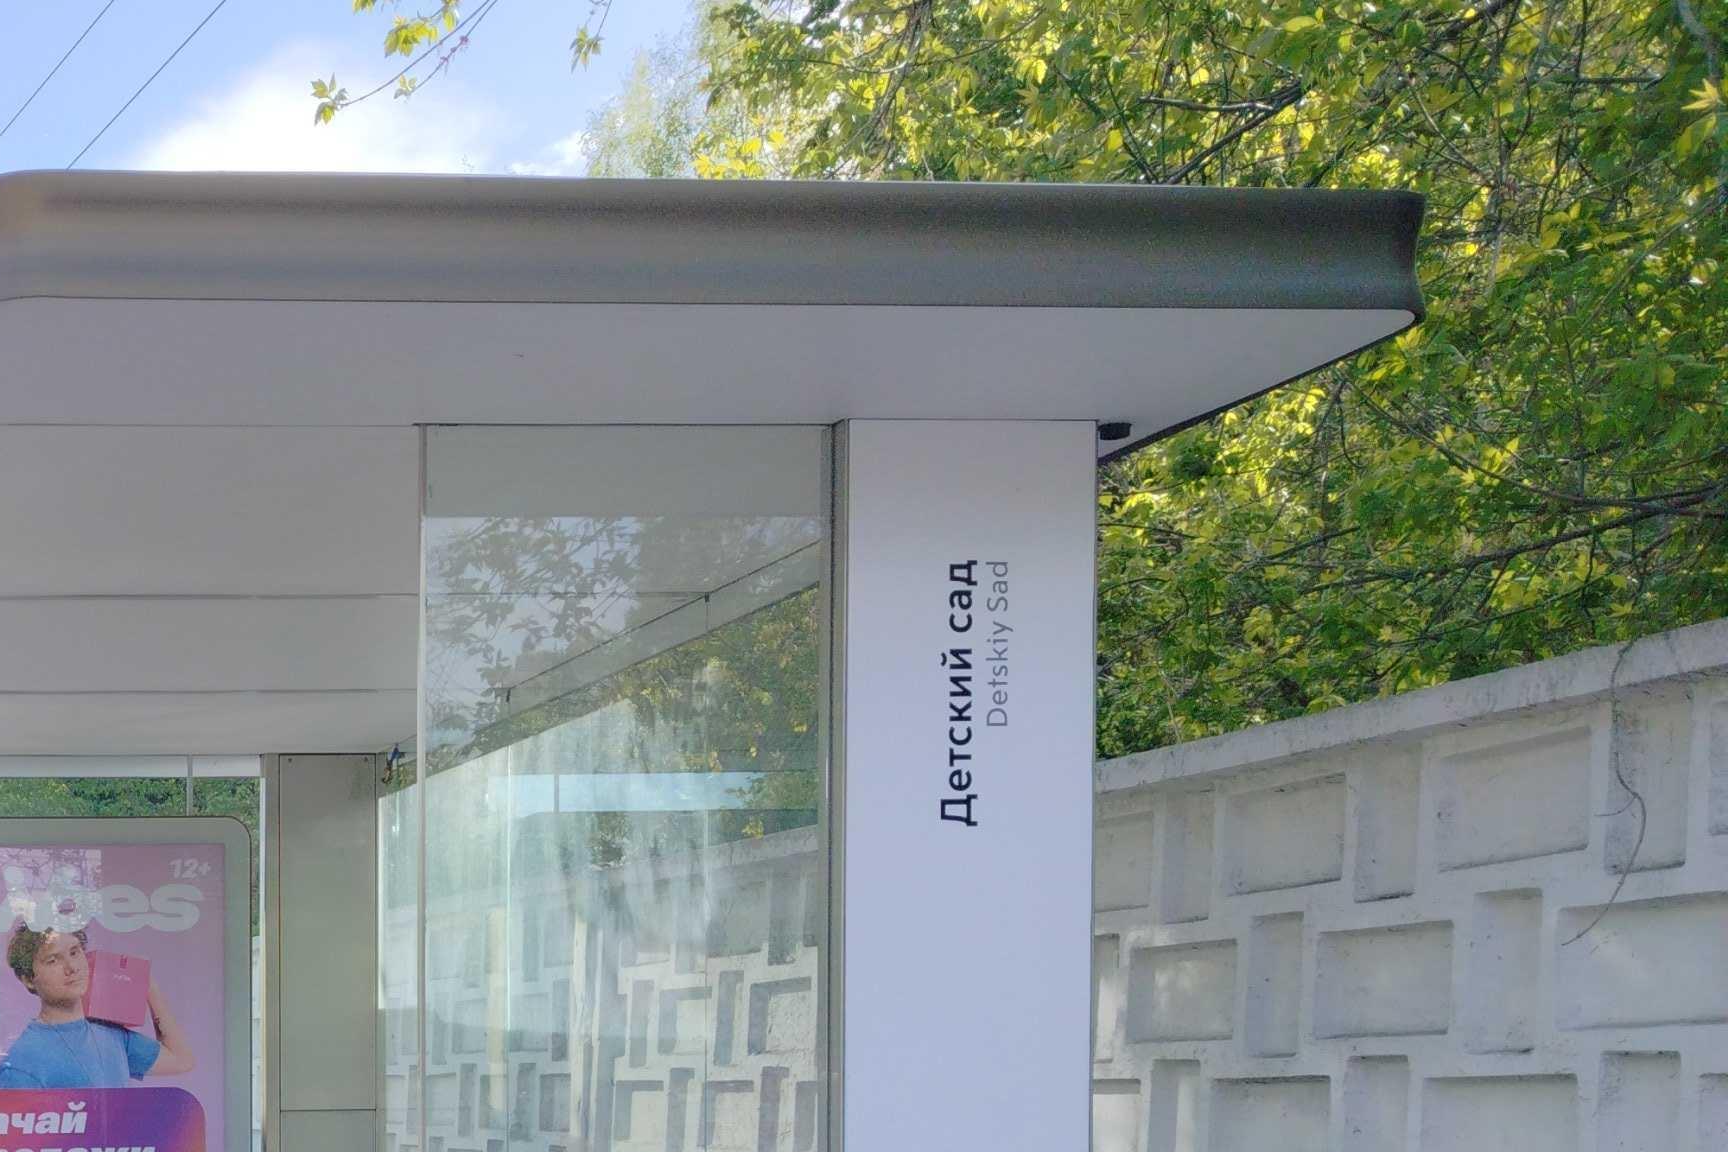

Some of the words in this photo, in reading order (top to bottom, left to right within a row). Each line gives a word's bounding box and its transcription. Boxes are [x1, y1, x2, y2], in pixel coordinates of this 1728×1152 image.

[948, 560, 978, 633] сад
[986, 561, 1009, 612] Sad
[986, 620, 1013, 727] Detskiy
[940, 649, 978, 827] Детский
[168, 858, 212, 880] 12+
